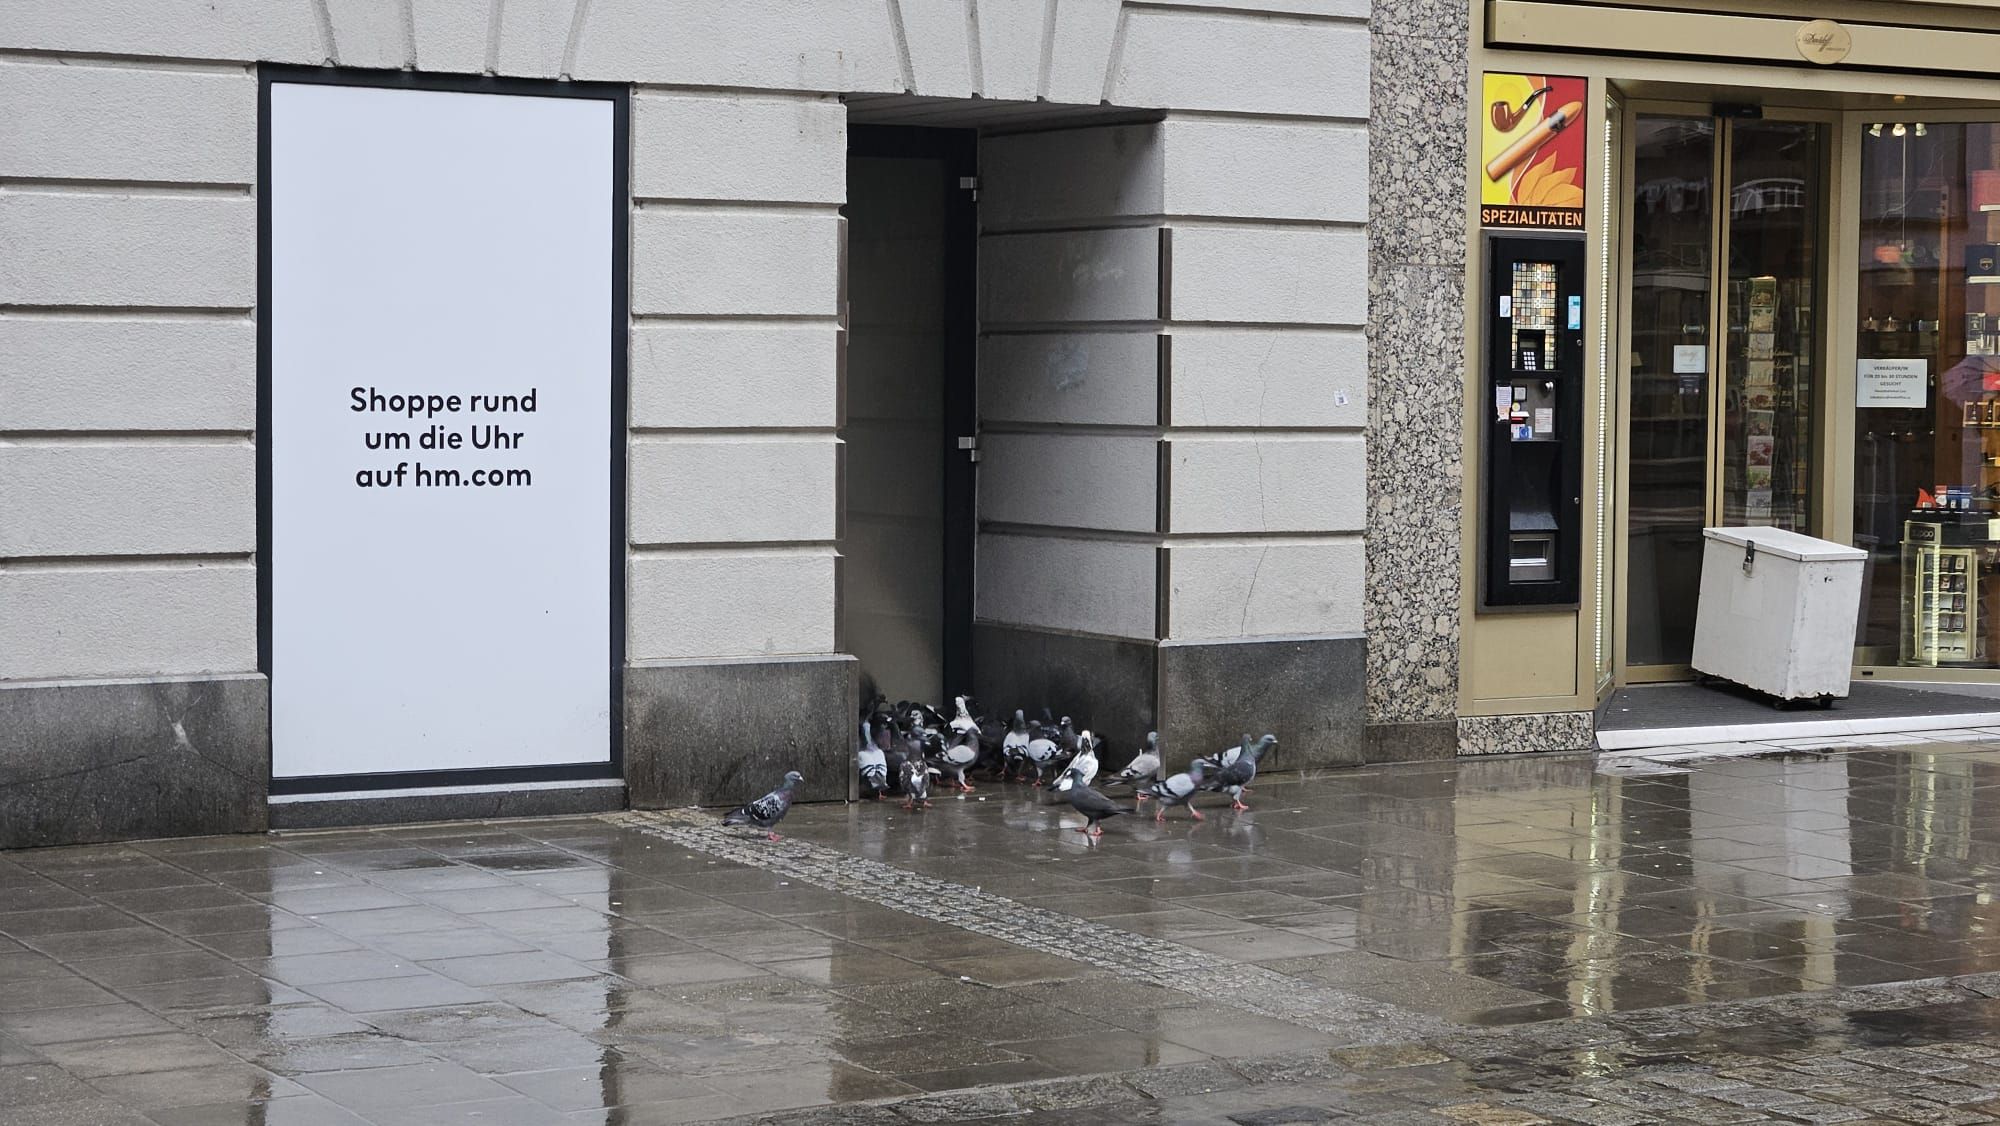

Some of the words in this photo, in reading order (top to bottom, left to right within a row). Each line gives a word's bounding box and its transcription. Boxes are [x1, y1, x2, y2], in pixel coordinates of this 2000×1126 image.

[1481, 208, 1582, 226] SPEZIALITÄTEN
[350, 386, 462, 419] Shoppe
[470, 387, 537, 413] rund
[365, 431, 411, 450] um
[418, 424, 463, 450] die
[471, 424, 525, 450] Uhr
[355, 461, 408, 488] auf
[415, 461, 532, 488] hm.com
